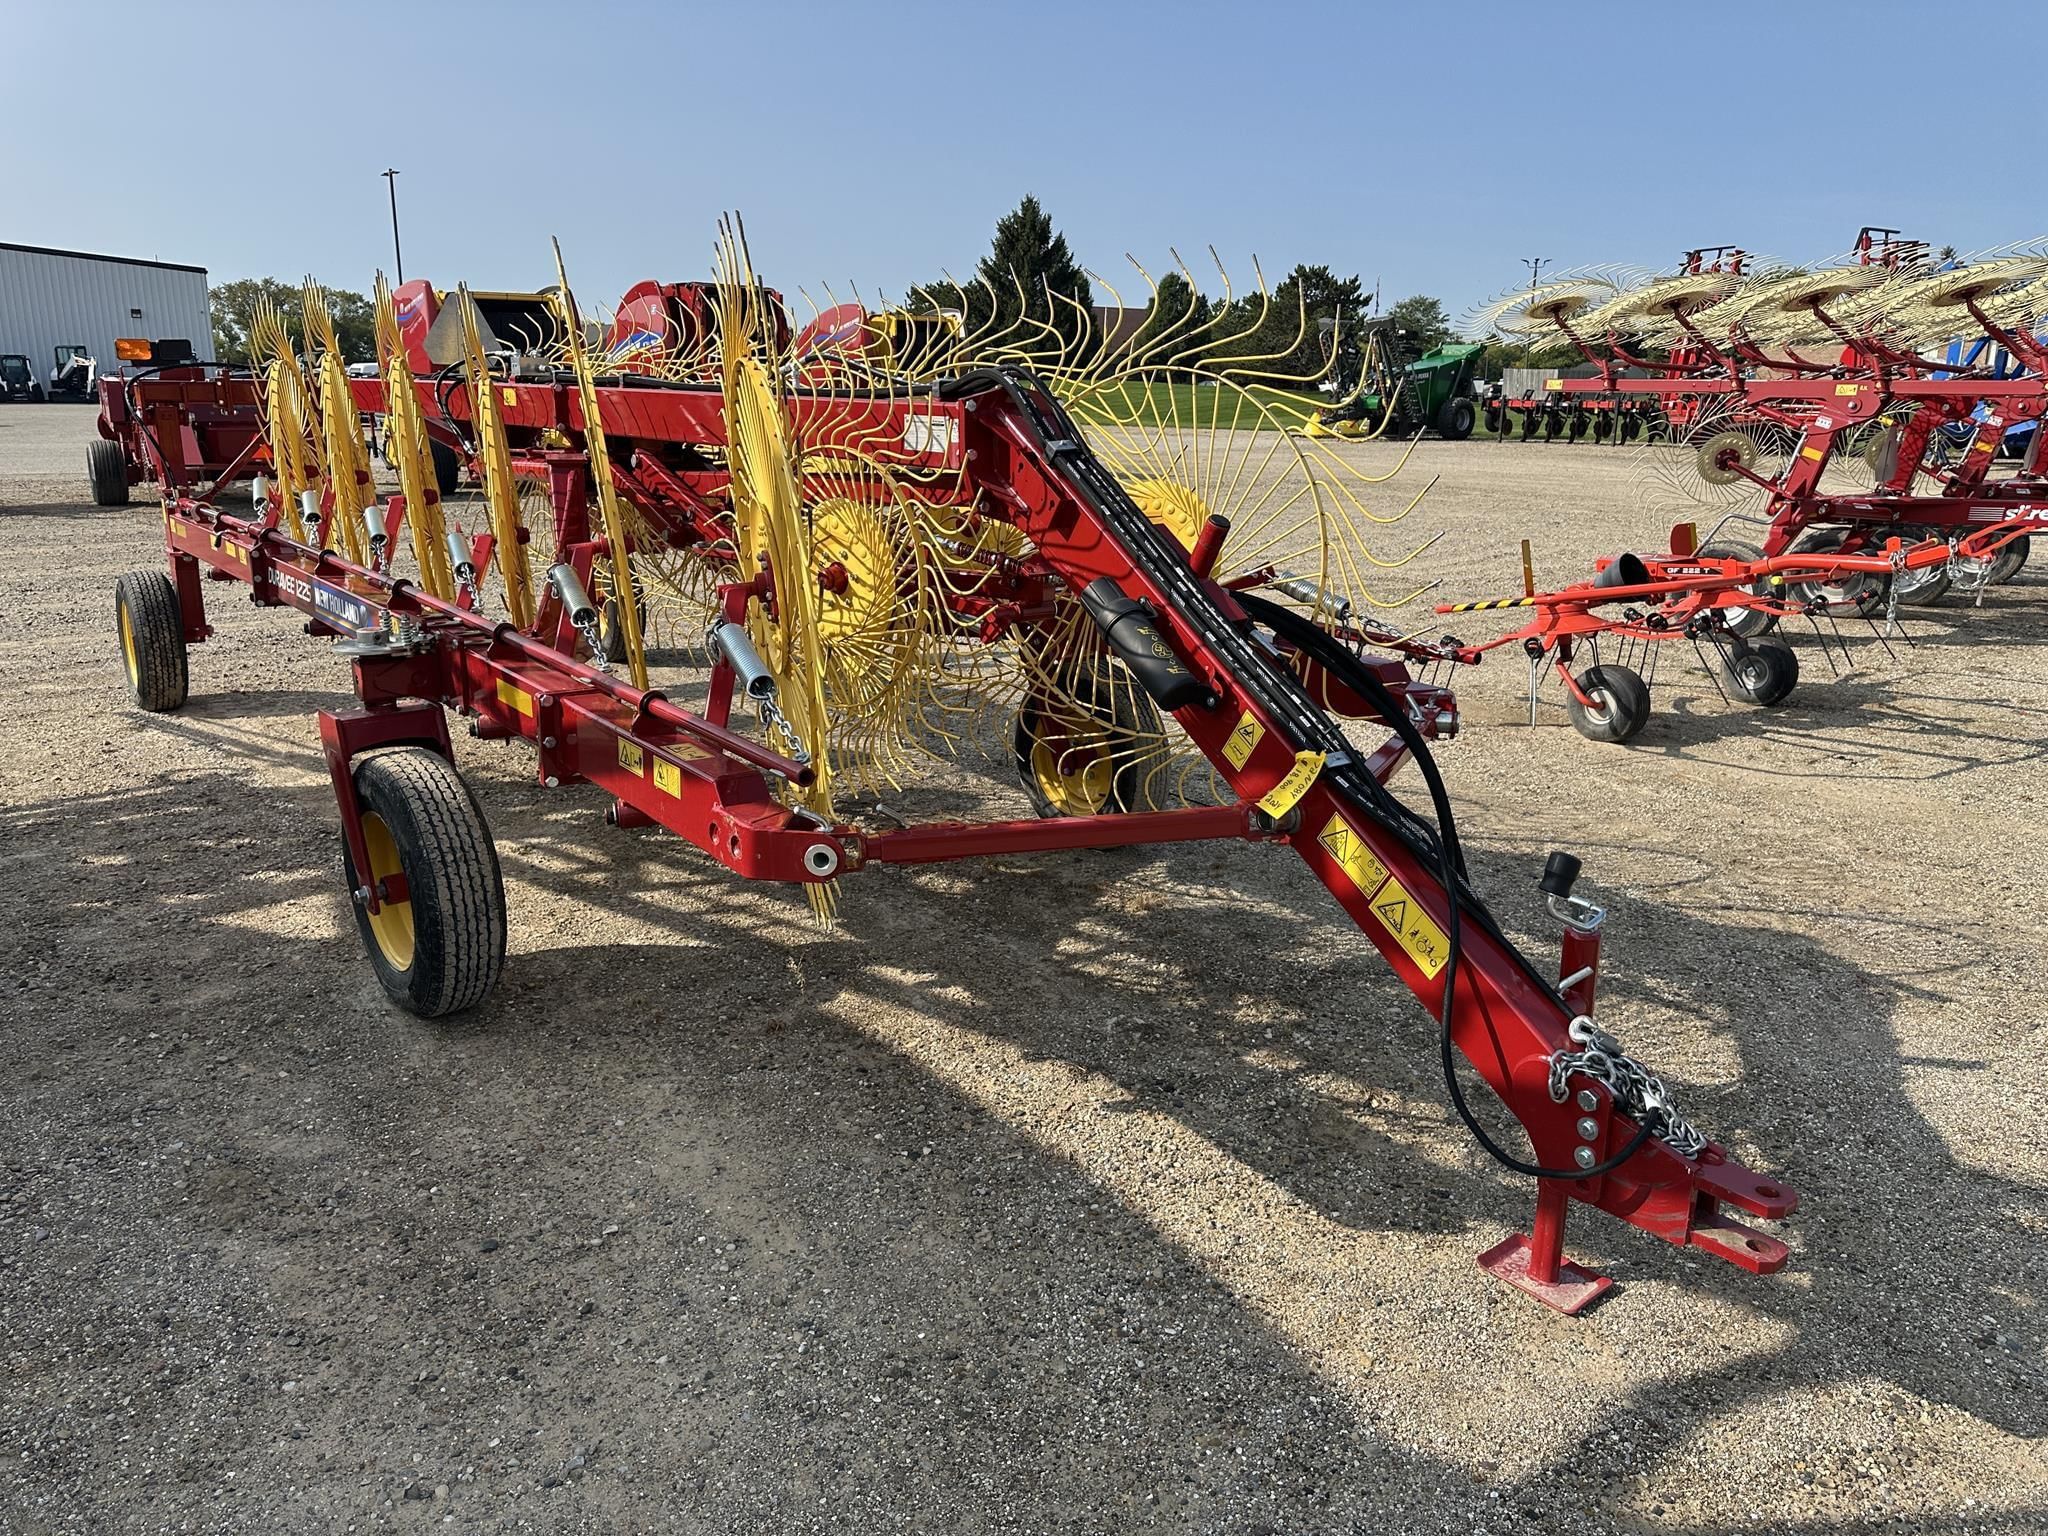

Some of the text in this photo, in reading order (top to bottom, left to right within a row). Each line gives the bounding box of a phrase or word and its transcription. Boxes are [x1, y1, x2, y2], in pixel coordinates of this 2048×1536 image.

[296, 578, 312, 602] 1225
[314, 586, 360, 624] NEW HOLLAND
